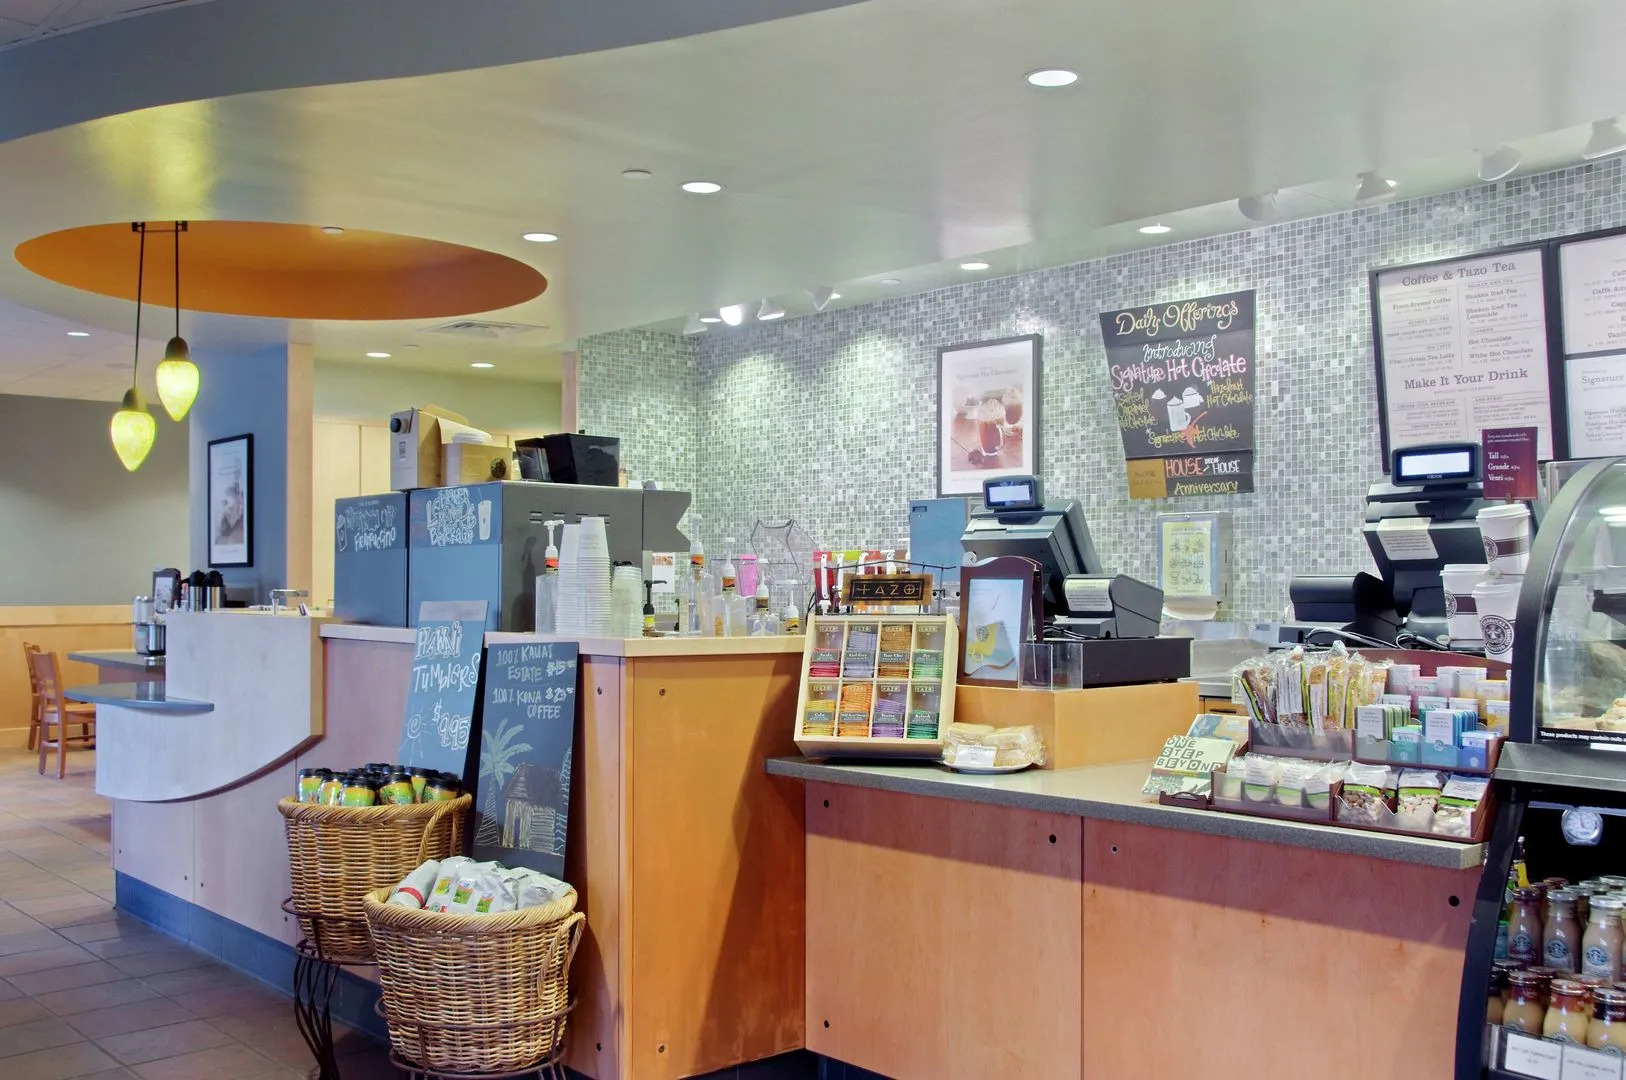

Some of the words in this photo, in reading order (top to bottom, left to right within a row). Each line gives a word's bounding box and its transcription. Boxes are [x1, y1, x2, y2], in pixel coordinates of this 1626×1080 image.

[1402, 271, 1438, 287] Coffee
[1442, 270, 1454, 281] &
[1456, 266, 1488, 278] Tazo
[1491, 262, 1516, 273] Tea
[1116, 308, 1161, 337] Daily
[1162, 300, 1239, 332] Offerings
[1142, 334, 1217, 362] Introducing
[1165, 357, 1191, 382] Hot
[1404, 377, 1437, 390] Make
[1439, 375, 1450, 386] It
[1453, 373, 1485, 385] Your
[1488, 368, 1529, 382] Drink
[1580, 375, 1625, 386] Signature
[1487, 451, 1500, 460] Tall
[1165, 457, 1204, 478] HOUSE
[1212, 459, 1241, 475] HOUSE
[1487, 462, 1510, 471] Grande
[1487, 473, 1504, 481] Venti
[1174, 480, 1239, 496] Anniversary
[496, 648, 519, 668] 100%
[521, 643, 554, 663] KAUAI
[508, 665, 543, 683] ESTATE
[492, 687, 514, 705] 100%
[516, 689, 542, 707] KONA
[526, 704, 562, 720] COFFEE
[1167, 737, 1197, 749] ONE
[1162, 747, 1204, 760] STEP
